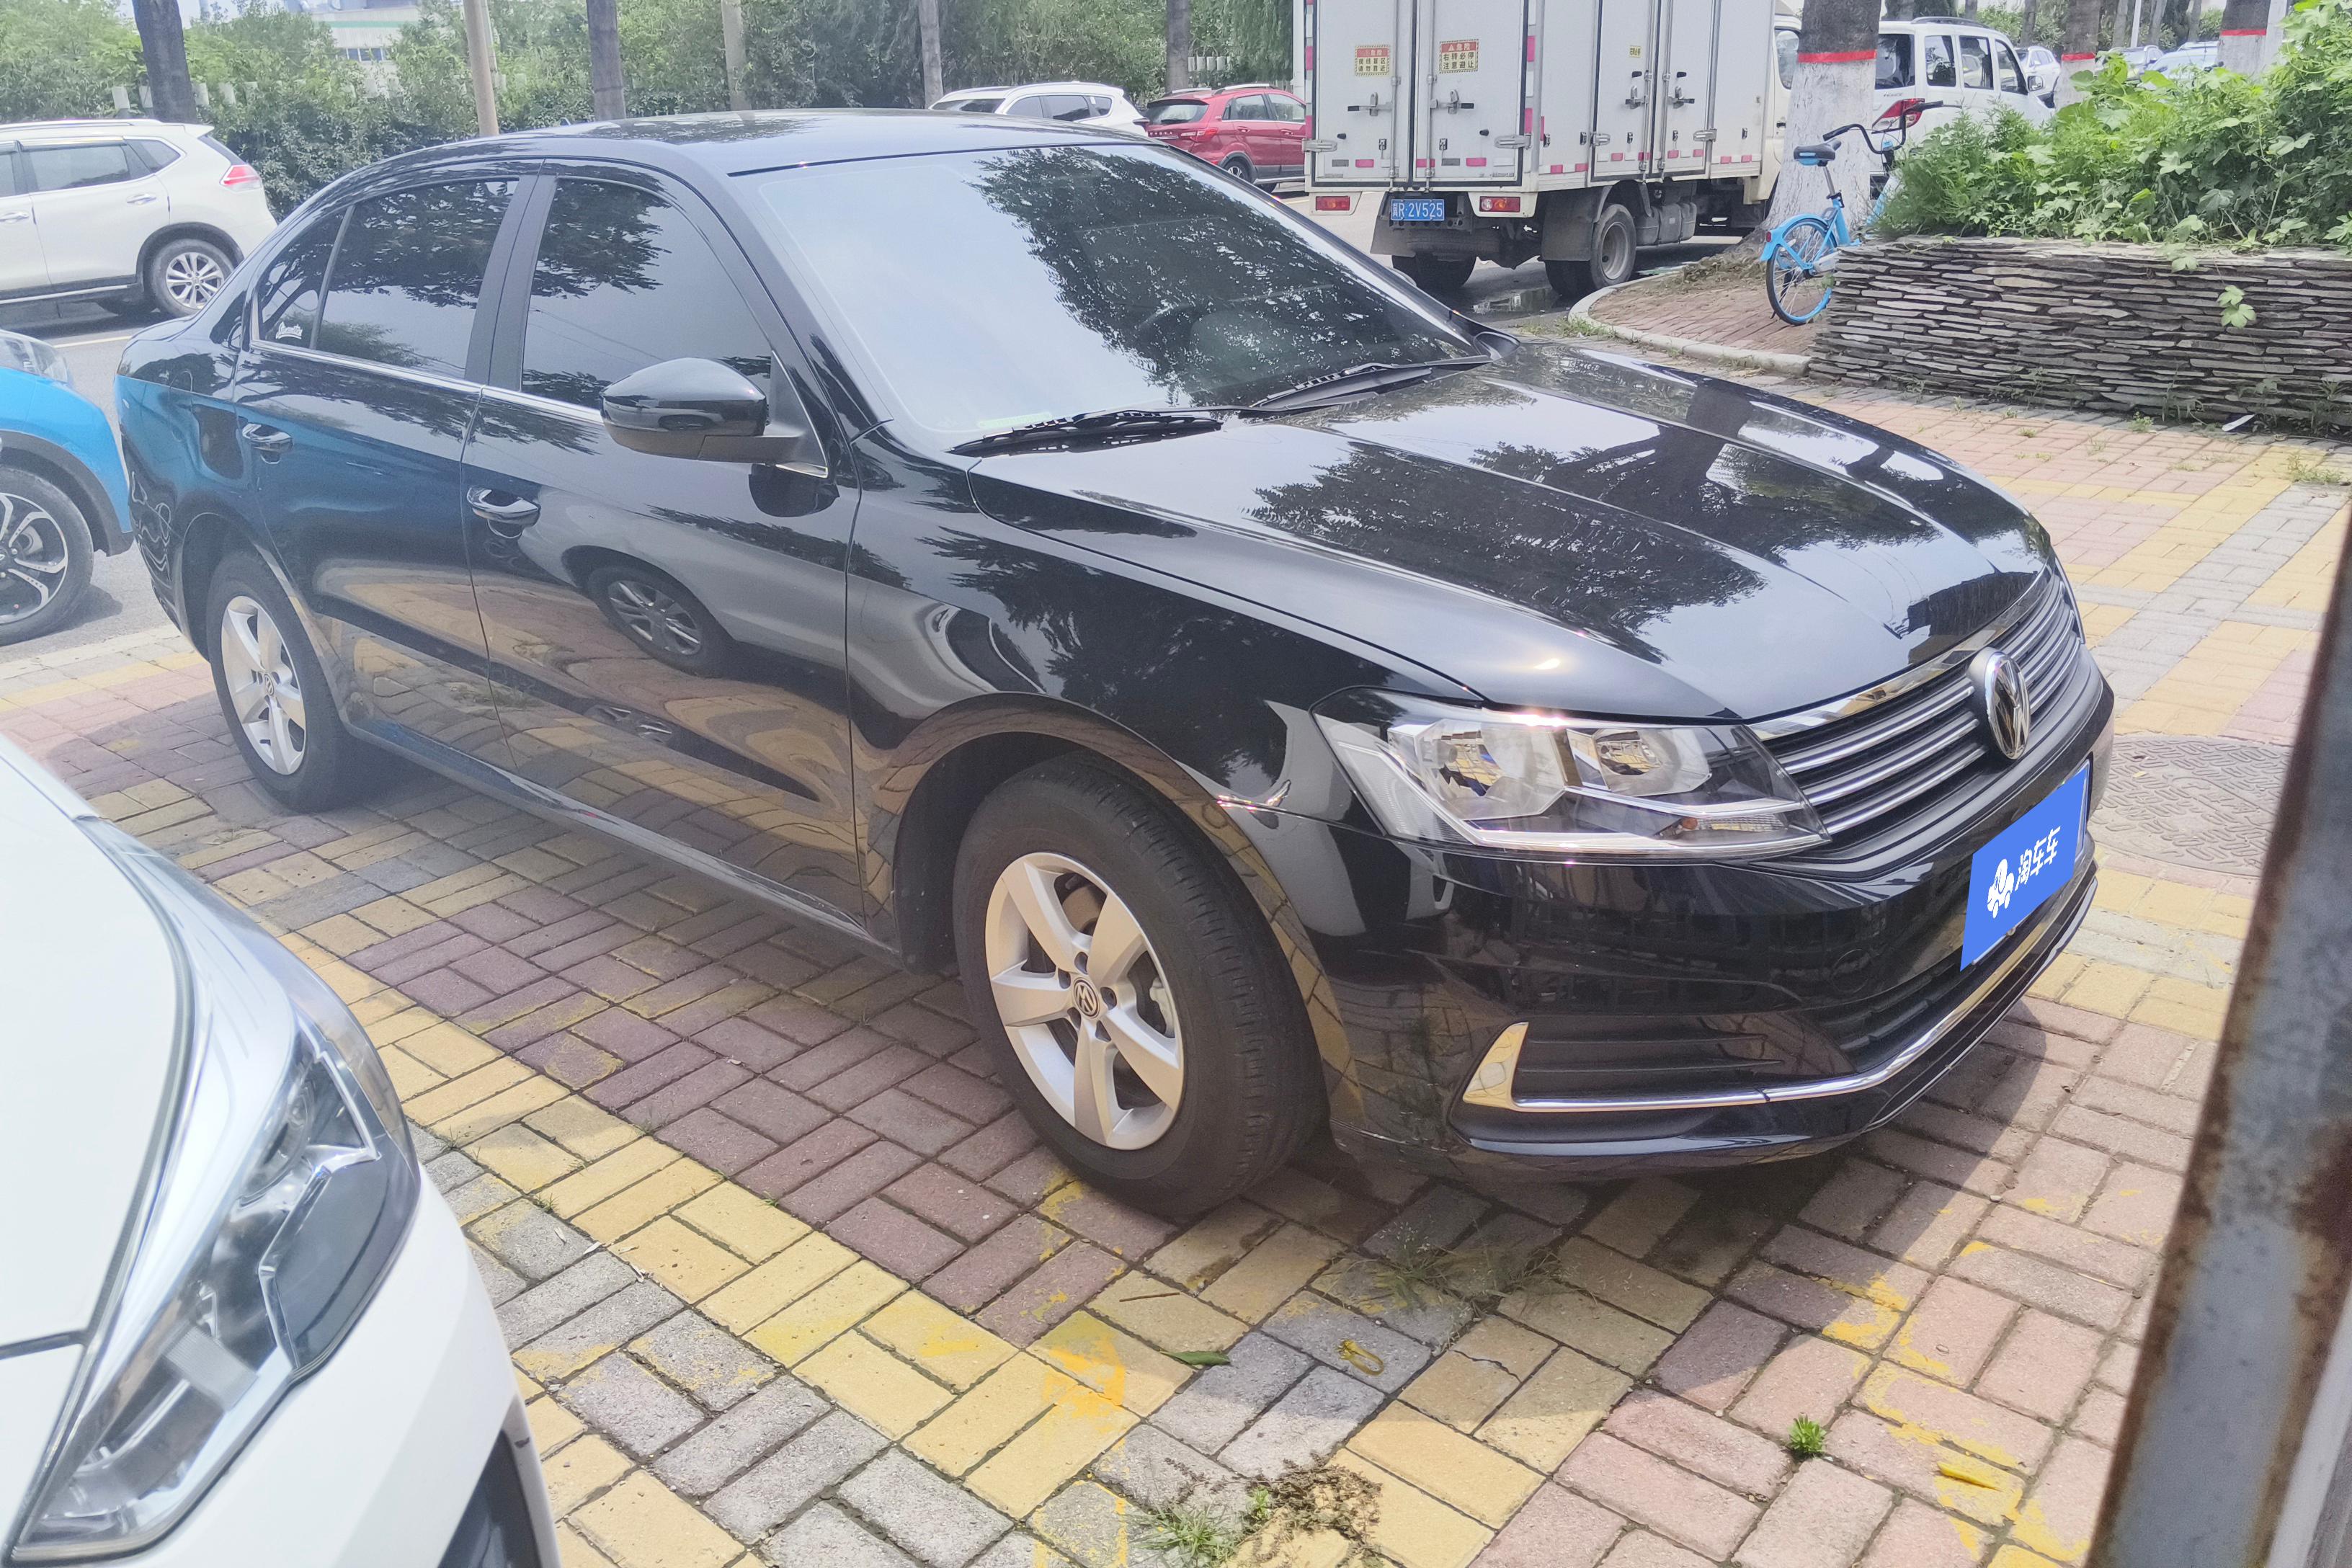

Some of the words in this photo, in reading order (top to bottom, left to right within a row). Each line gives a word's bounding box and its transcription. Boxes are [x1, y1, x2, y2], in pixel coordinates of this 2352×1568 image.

[1443, 52, 1474, 61] 右转必停
[1443, 61, 1474, 70] 注意避让
